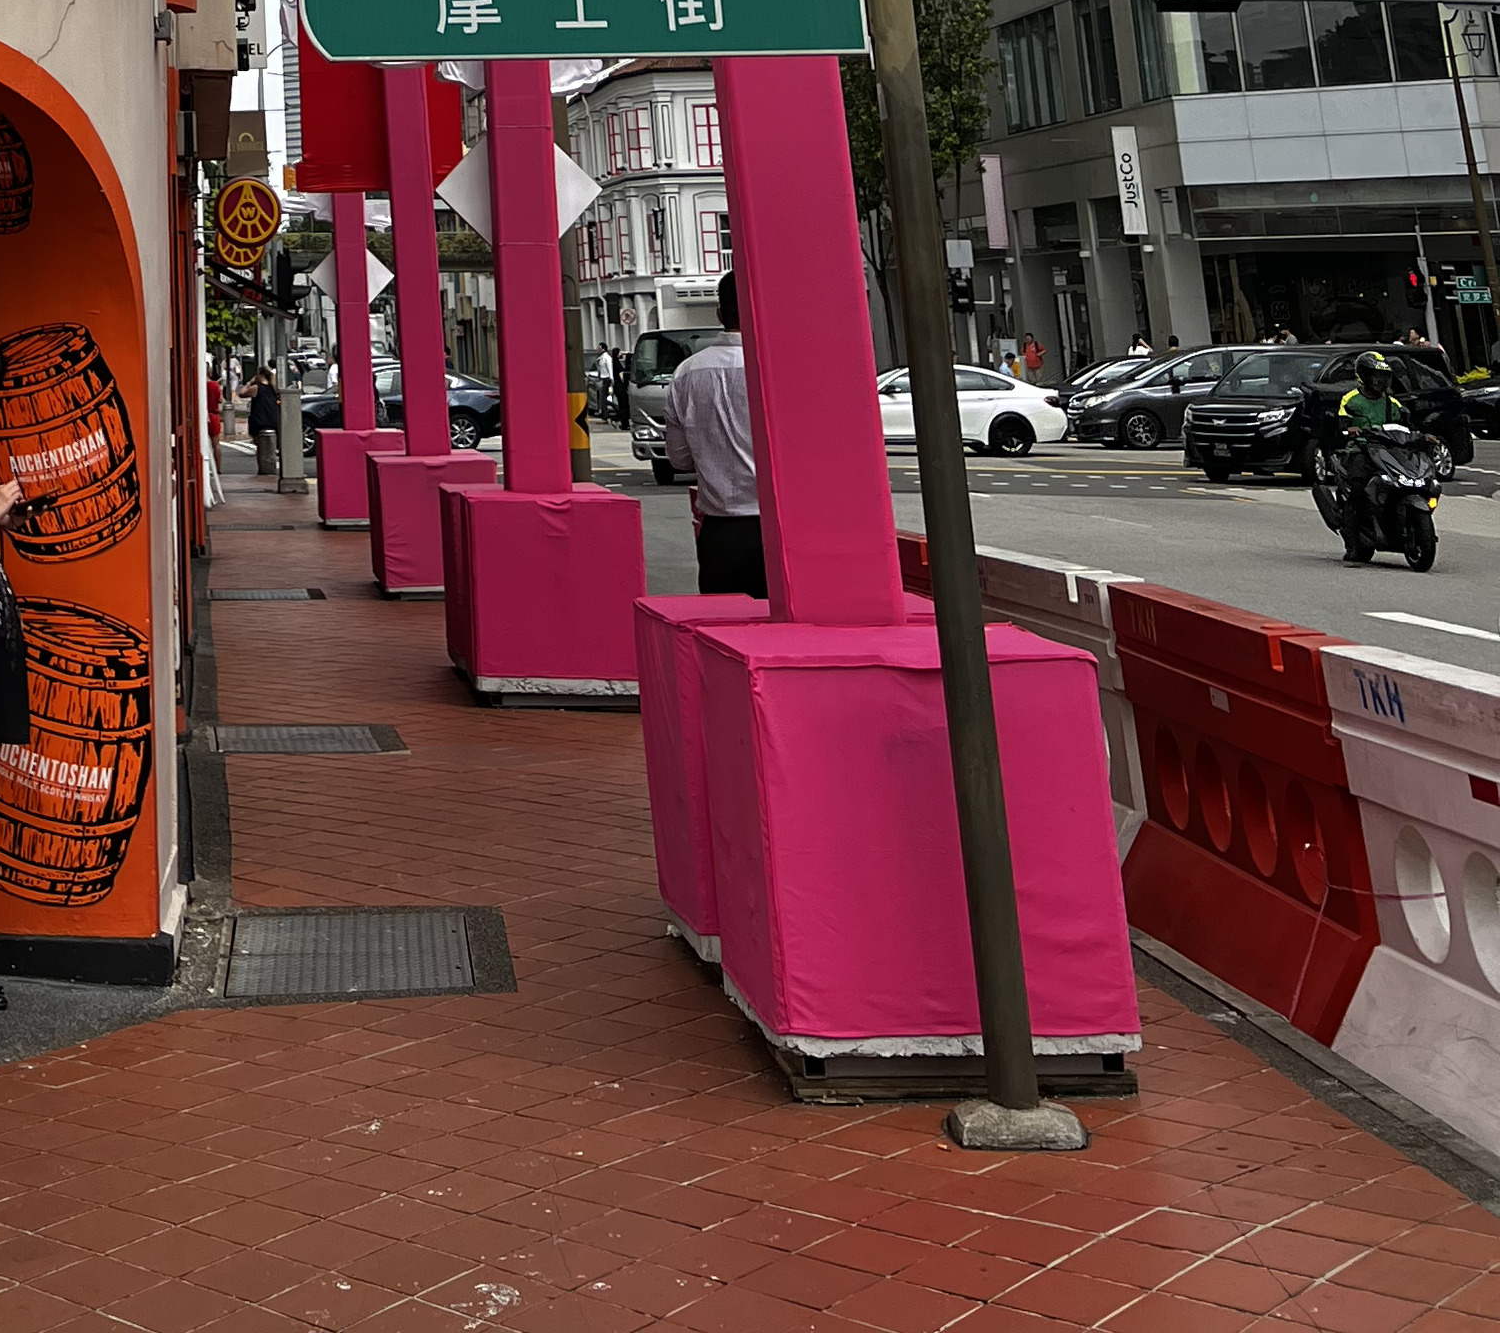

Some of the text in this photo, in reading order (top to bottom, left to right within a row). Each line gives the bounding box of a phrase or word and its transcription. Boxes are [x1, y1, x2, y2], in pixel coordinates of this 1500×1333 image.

[1120, 153, 1138, 208] JustCo
[9, 429, 107, 472] AUCHENTOSHAN
[1352, 668, 1405, 723] TKH
[40, 784, 72, 800] SCOTCH
